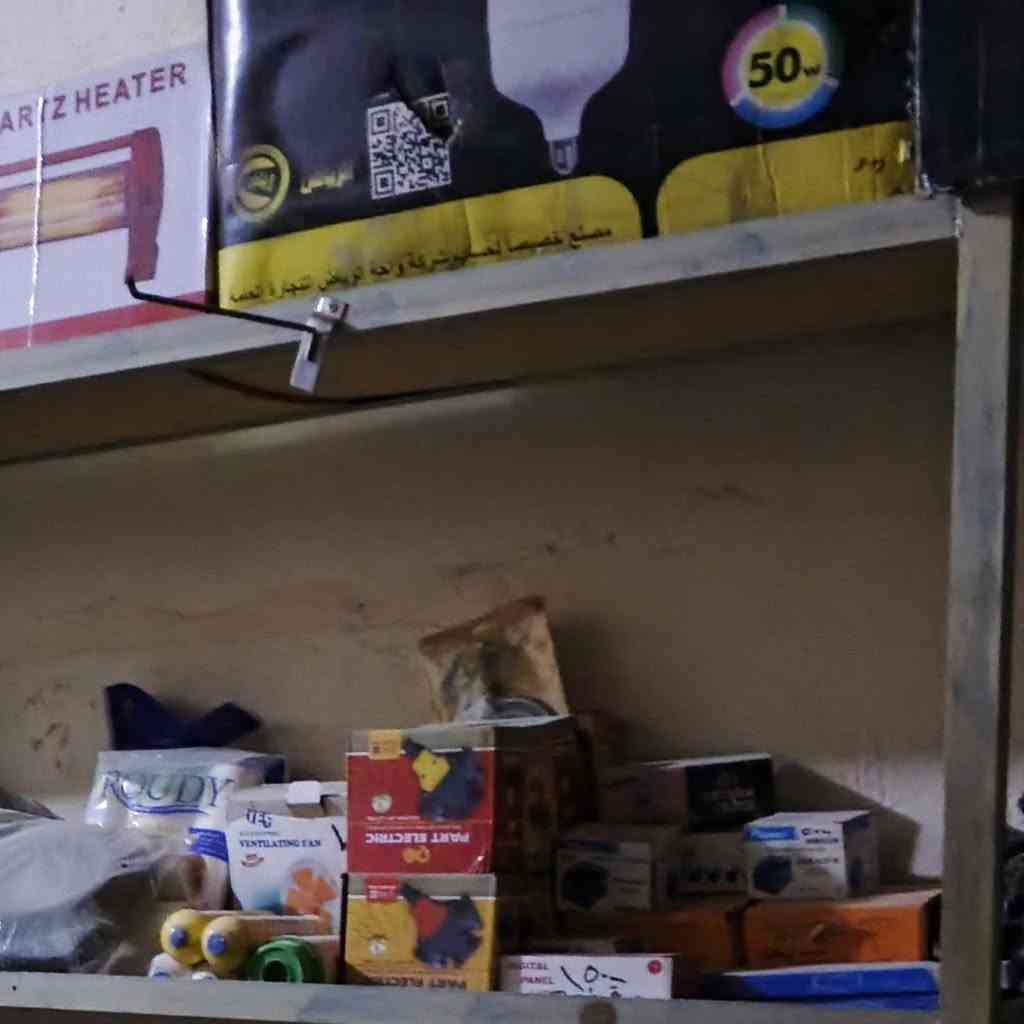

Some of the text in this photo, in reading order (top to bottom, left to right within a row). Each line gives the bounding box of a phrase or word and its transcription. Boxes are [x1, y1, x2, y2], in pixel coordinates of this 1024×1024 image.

[75, 62, 188, 114] HEATER
[239, 839, 301, 849] VENTILATING
[365, 831, 428, 845] ELECTRIC
